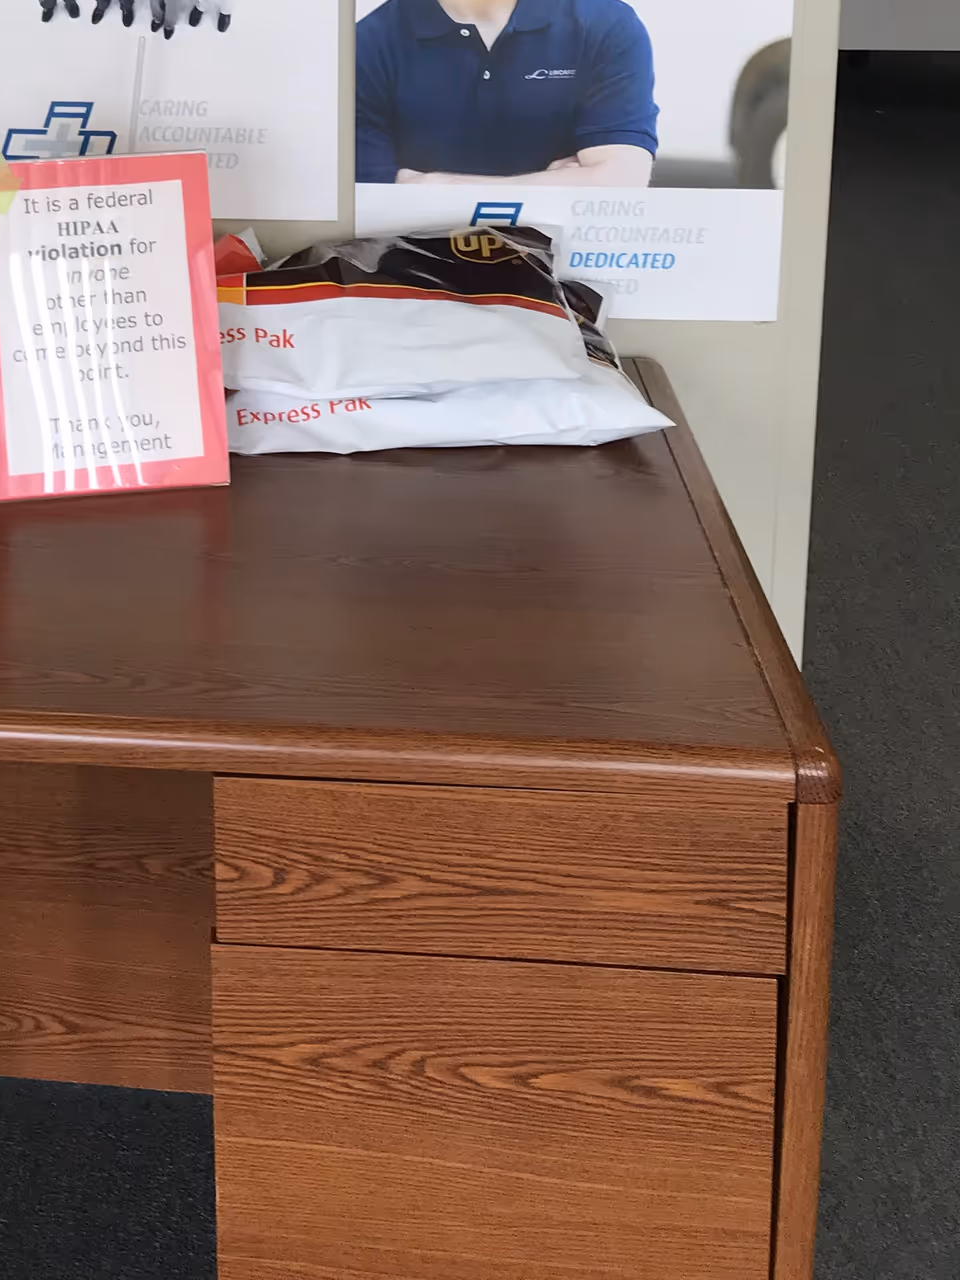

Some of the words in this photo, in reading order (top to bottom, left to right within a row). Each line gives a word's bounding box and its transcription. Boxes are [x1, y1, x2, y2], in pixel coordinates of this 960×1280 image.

[139, 99, 209, 117] CARING
[140, 126, 269, 145] ACCOUNTABLE
[24, 198, 40, 214] It
[47, 197, 61, 212] is
[69, 197, 79, 210] a
[87, 189, 153, 209] federal
[571, 200, 645, 217] CARING
[58, 220, 120, 236] HIPAA
[570, 226, 707, 244] ACCOUNTABLE
[130, 238, 157, 255] for
[457, 234, 504, 257] up
[569, 251, 675, 269] DEDICATED
[144, 312, 164, 327] to
[152, 333, 187, 351] this
[254, 327, 296, 349] Pak
[236, 402, 321, 427] Express
